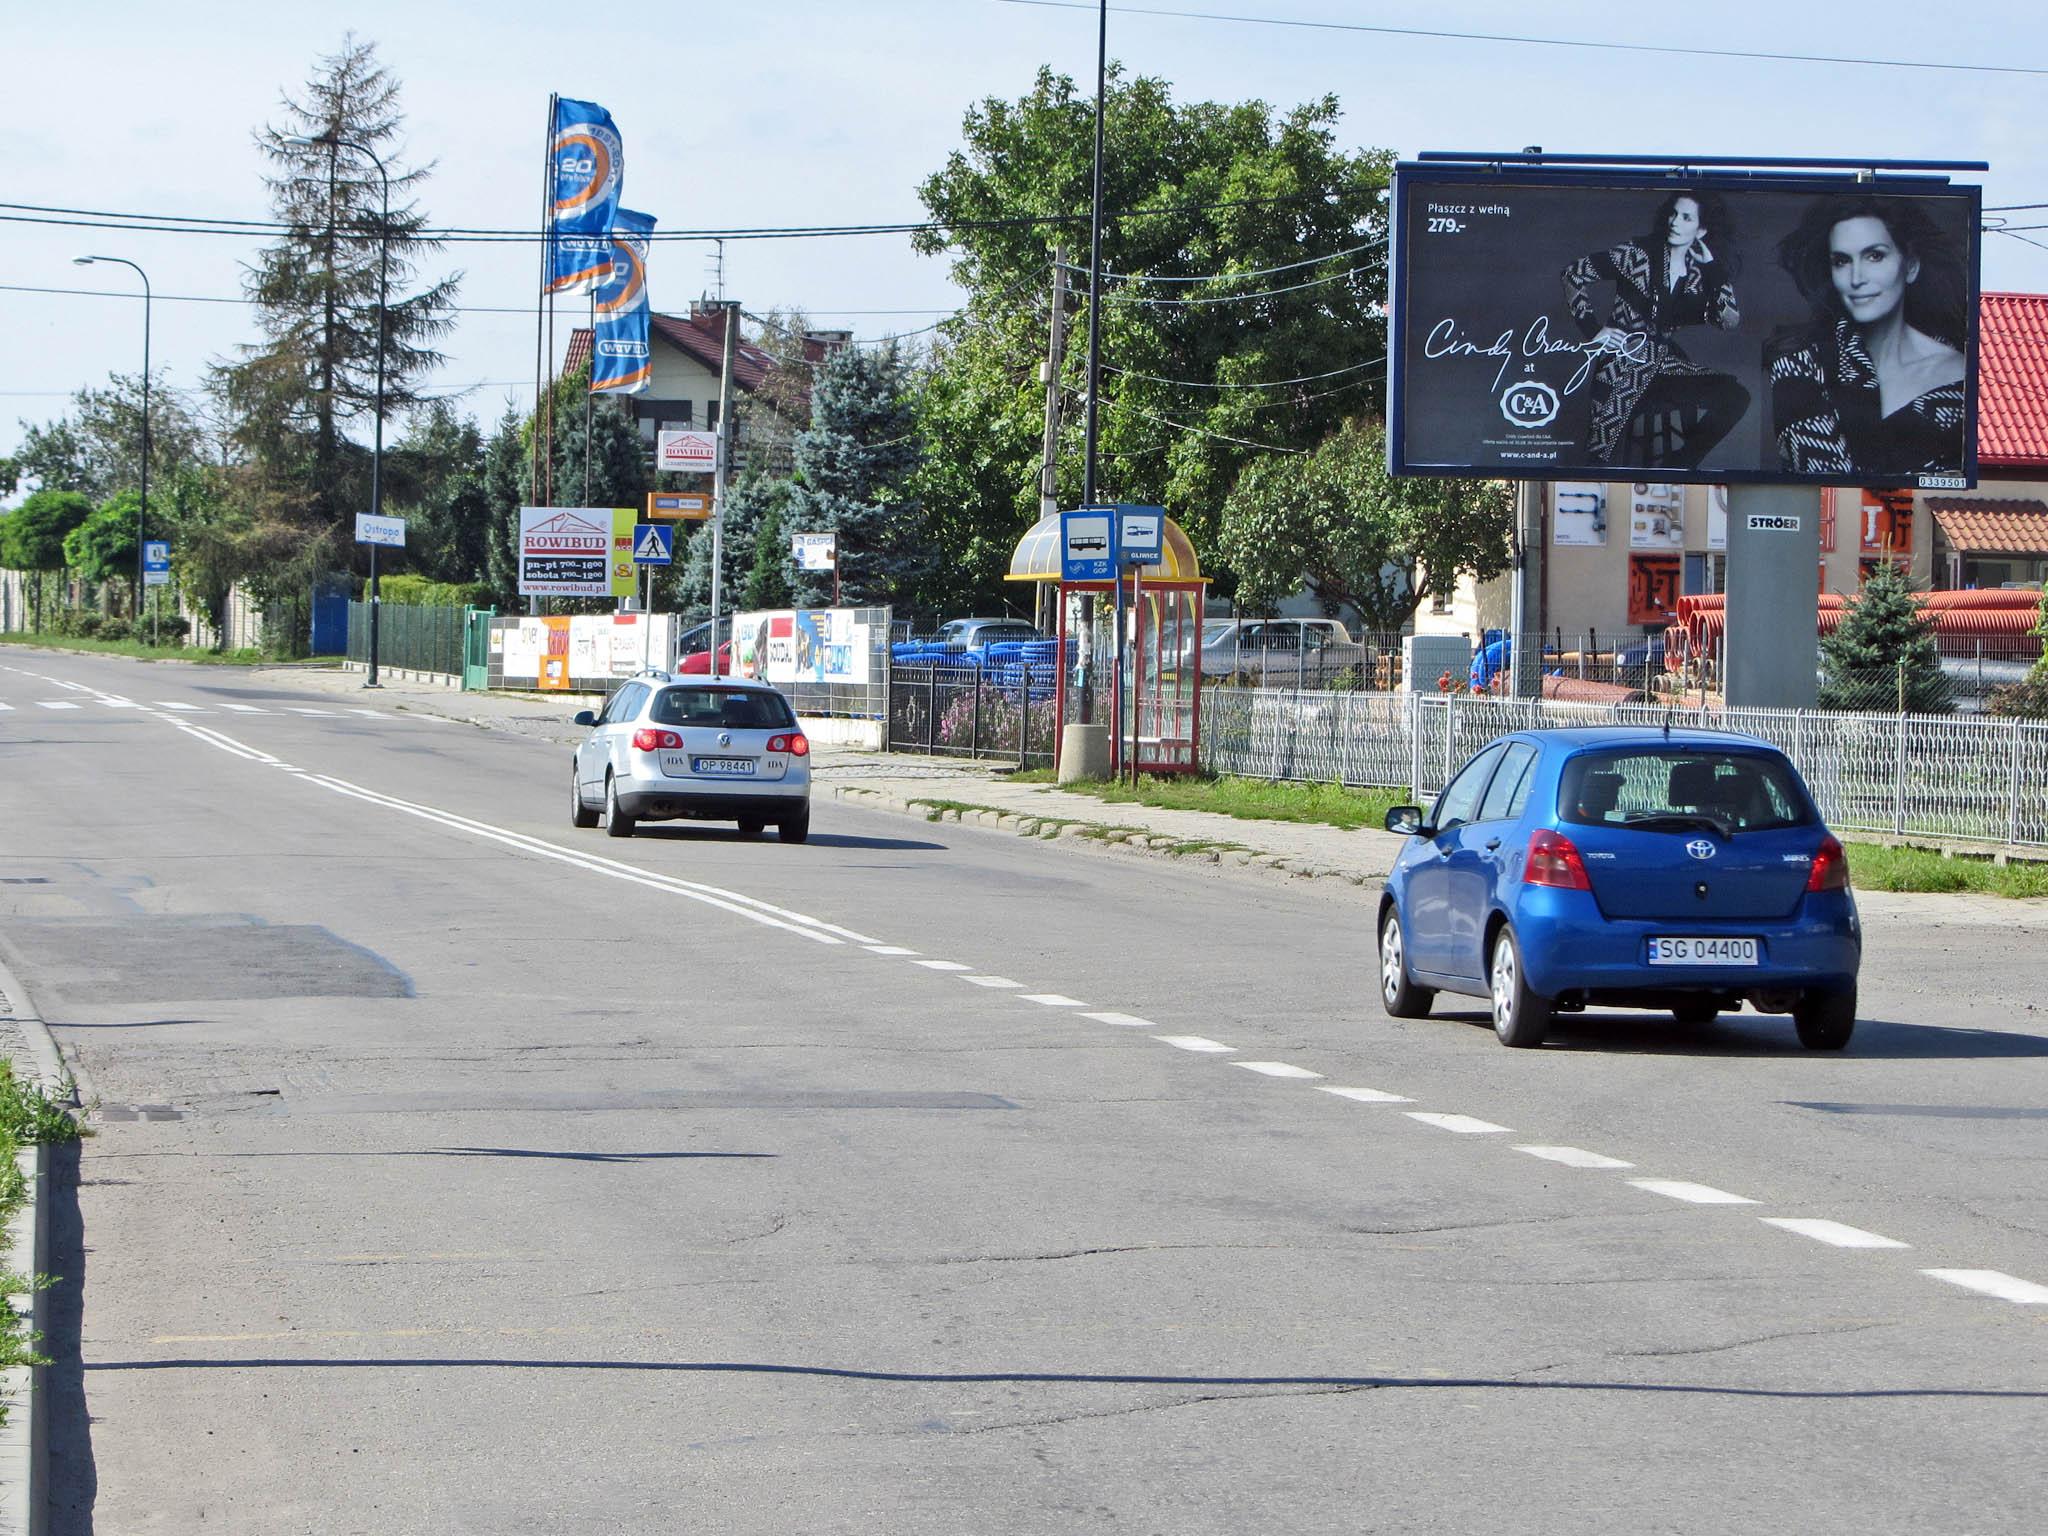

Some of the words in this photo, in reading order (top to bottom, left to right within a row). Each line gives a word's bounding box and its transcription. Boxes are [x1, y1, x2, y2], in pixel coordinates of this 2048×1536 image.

[1427, 203, 1466, 214] Płaszcz
[1469, 206, 1475, 214] z
[1478, 204, 1510, 217] wełną
[1427, 217, 1466, 233] 279.-
[1424, 318, 1514, 393] Cindy
[1522, 316, 1647, 396] Crawford
[1523, 363, 1535, 373] at
[1510, 393, 1550, 415] C&A
[666, 448, 714, 457] ROWIBUD
[1500, 451, 1558, 460] www.c-and-a.pl
[1919, 475, 1966, 489] 0339501
[1750, 516, 1799, 530] STRÖER
[525, 536, 607, 549] ROWIBUD
[1130, 552, 1159, 560] GLIWICE
[526, 560, 558, 571] pn-pt
[1092, 567, 1108, 575] GOP
[526, 570, 559, 580] sobota
[523, 583, 607, 594] www.rowibud.pl
[701, 760, 717, 771] OP
[719, 760, 752, 772] 98441
[1659, 939, 1688, 959] SG
[1694, 940, 1754, 959] 04400
